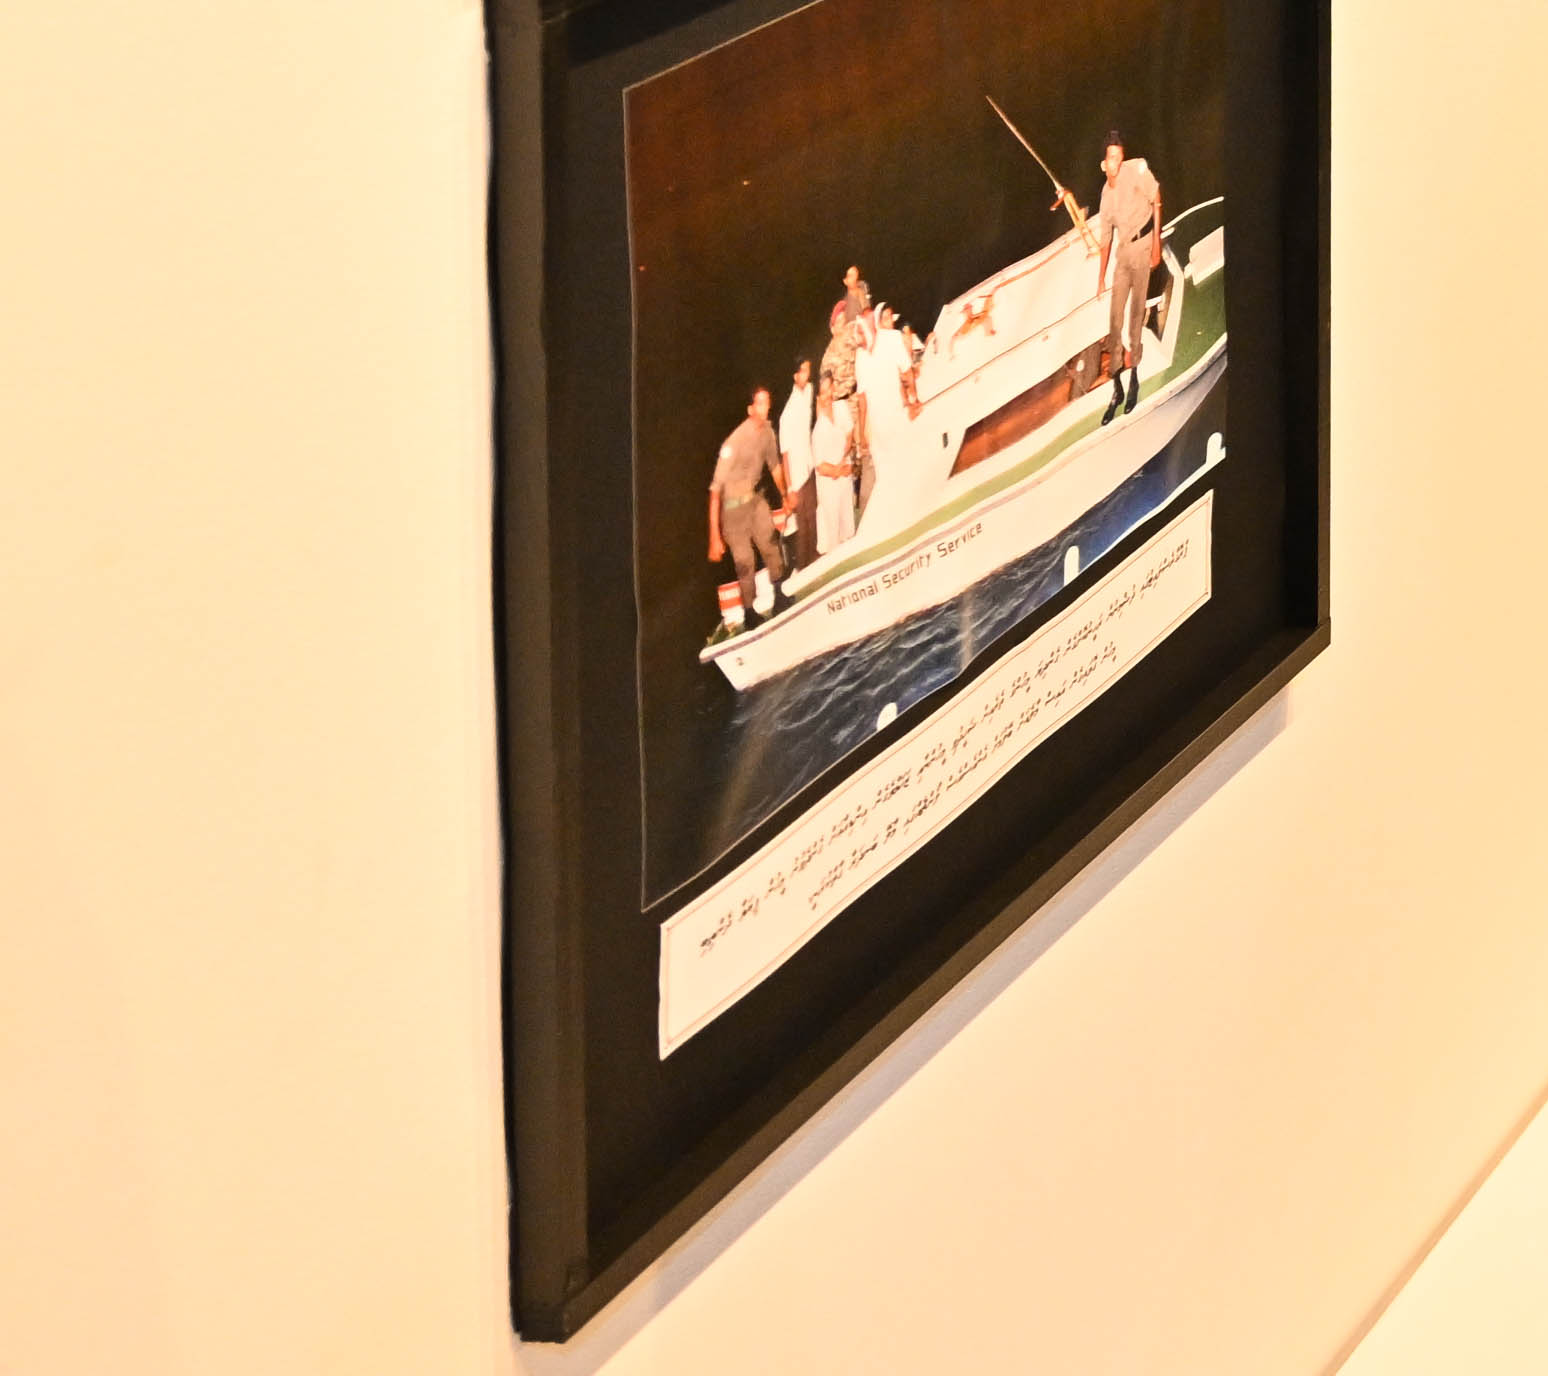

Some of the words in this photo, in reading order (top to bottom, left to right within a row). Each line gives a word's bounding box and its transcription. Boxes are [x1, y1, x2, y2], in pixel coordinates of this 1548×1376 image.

[827, 581, 879, 615] National
[881, 551, 932, 590] Security
[936, 521, 983, 559] Service
